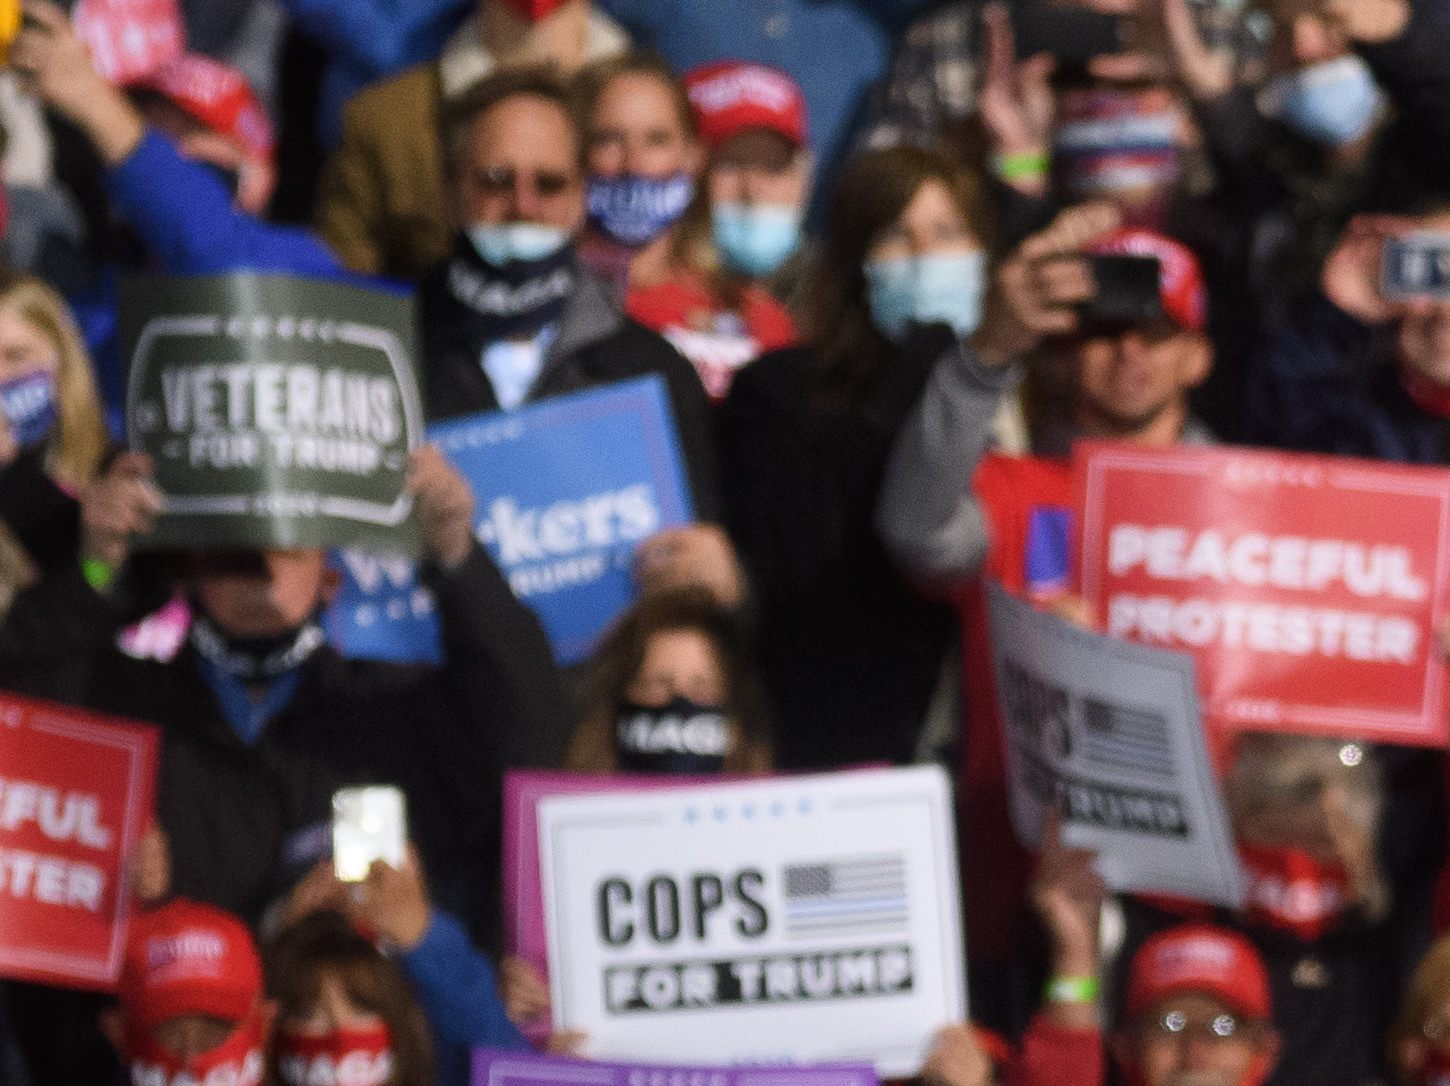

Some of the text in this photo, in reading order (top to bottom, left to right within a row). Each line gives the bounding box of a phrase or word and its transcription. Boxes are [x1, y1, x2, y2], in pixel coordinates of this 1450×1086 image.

[162, 363, 399, 444] VETERANS
[190, 432, 379, 477] FOR TRUMP
[1108, 525, 1428, 599] PEACEFUL
[1108, 594, 1420, 666] PROTESTER
[618, 711, 730, 756] MAG
[598, 866, 770, 948] COPS
[610, 947, 913, 1012] FOR TRUMP
